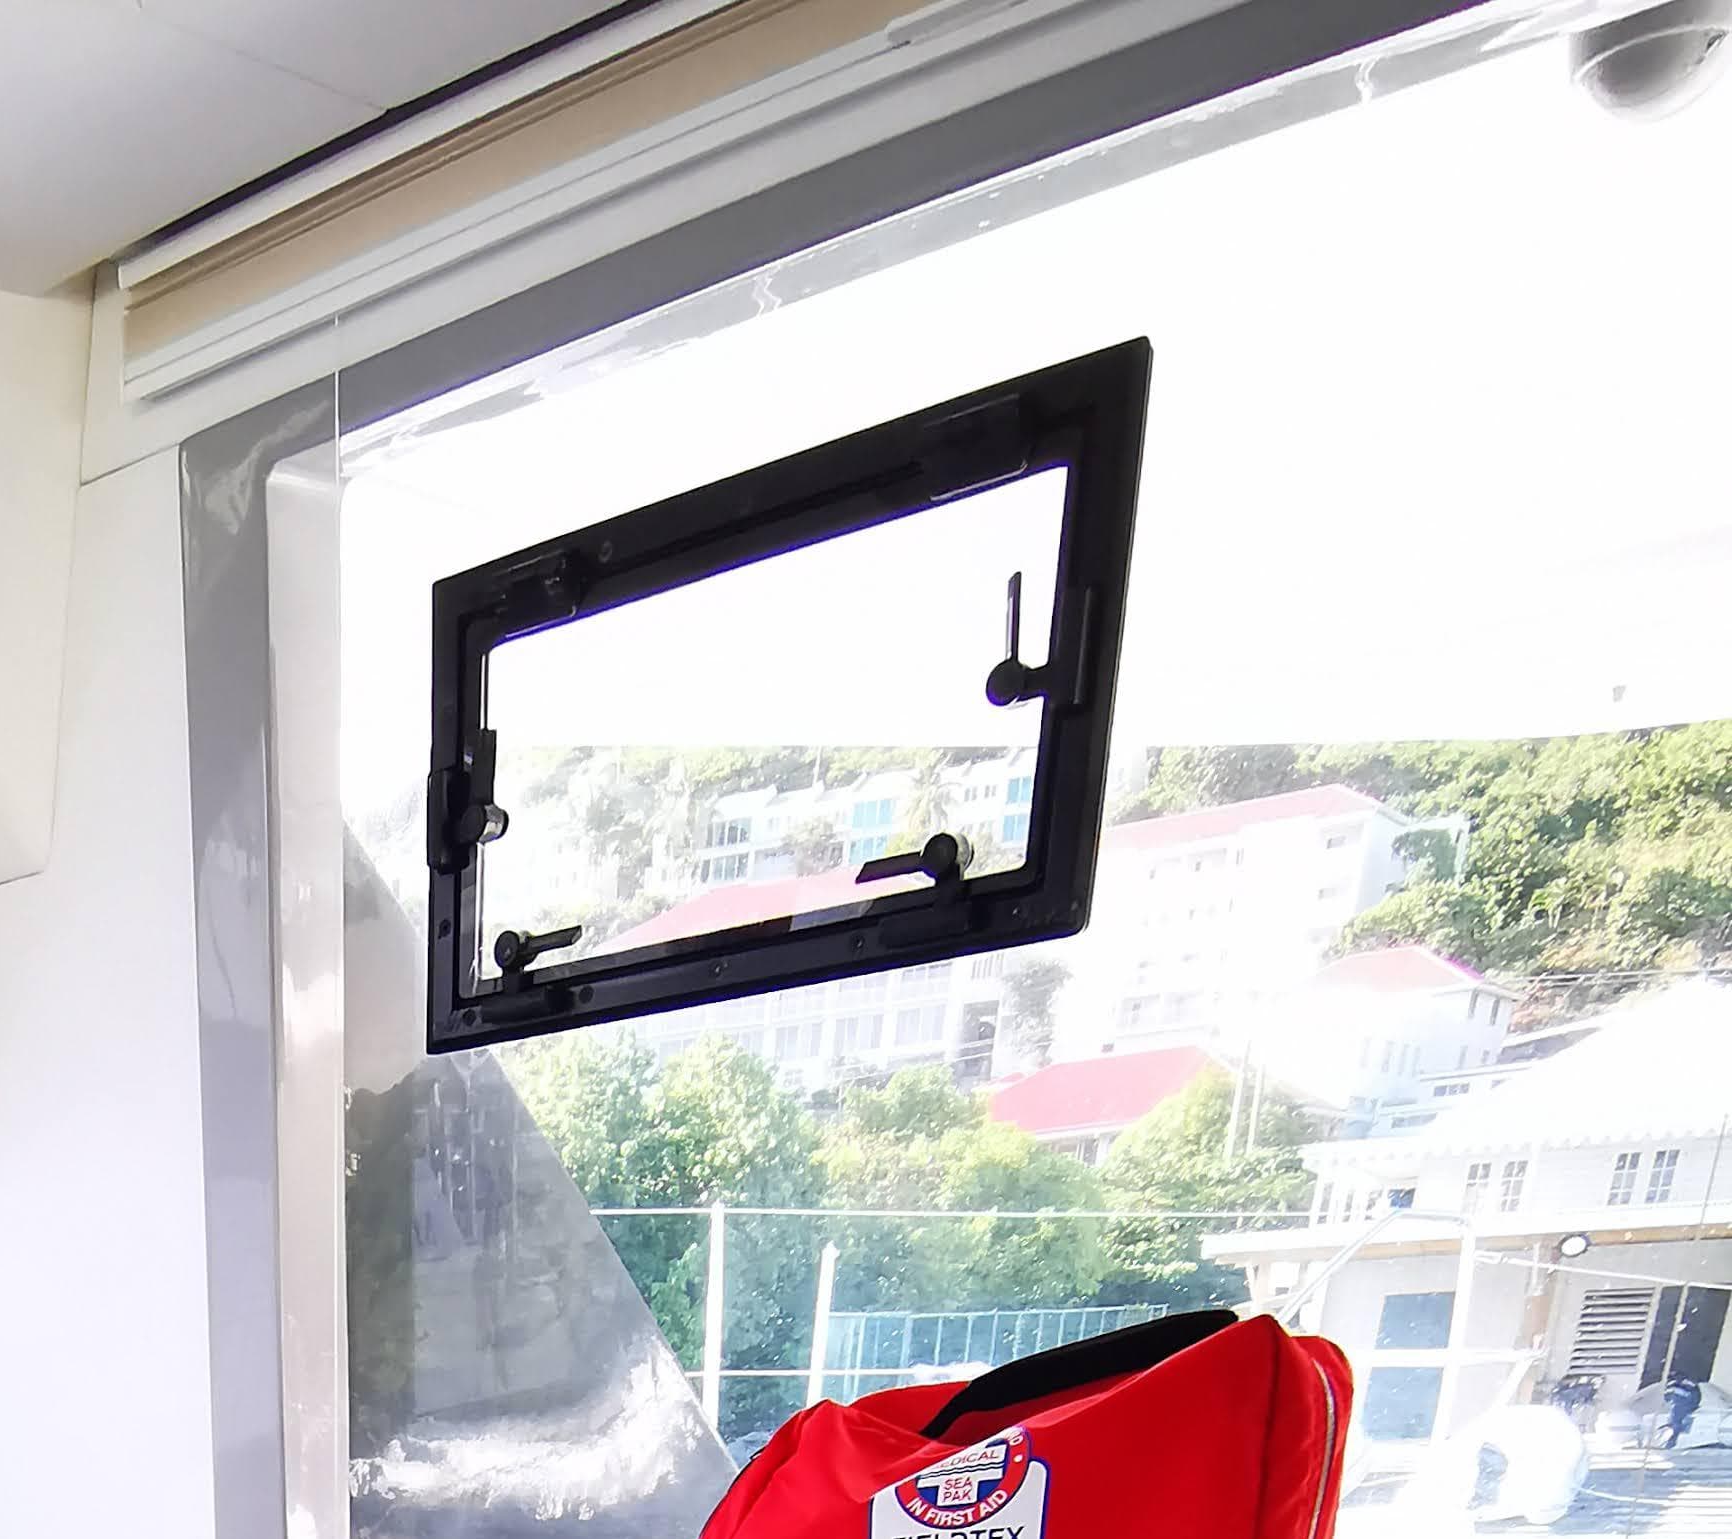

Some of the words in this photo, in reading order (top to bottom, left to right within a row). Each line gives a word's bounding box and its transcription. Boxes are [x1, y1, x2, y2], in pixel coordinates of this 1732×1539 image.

[935, 1450, 999, 1469] DICAL
[944, 1477, 972, 1490] SEA
[943, 1489, 972, 1502] PAK
[906, 1497, 927, 1516] IN
[924, 1507, 976, 1527] FIRST
[979, 1490, 1008, 1518] AID
